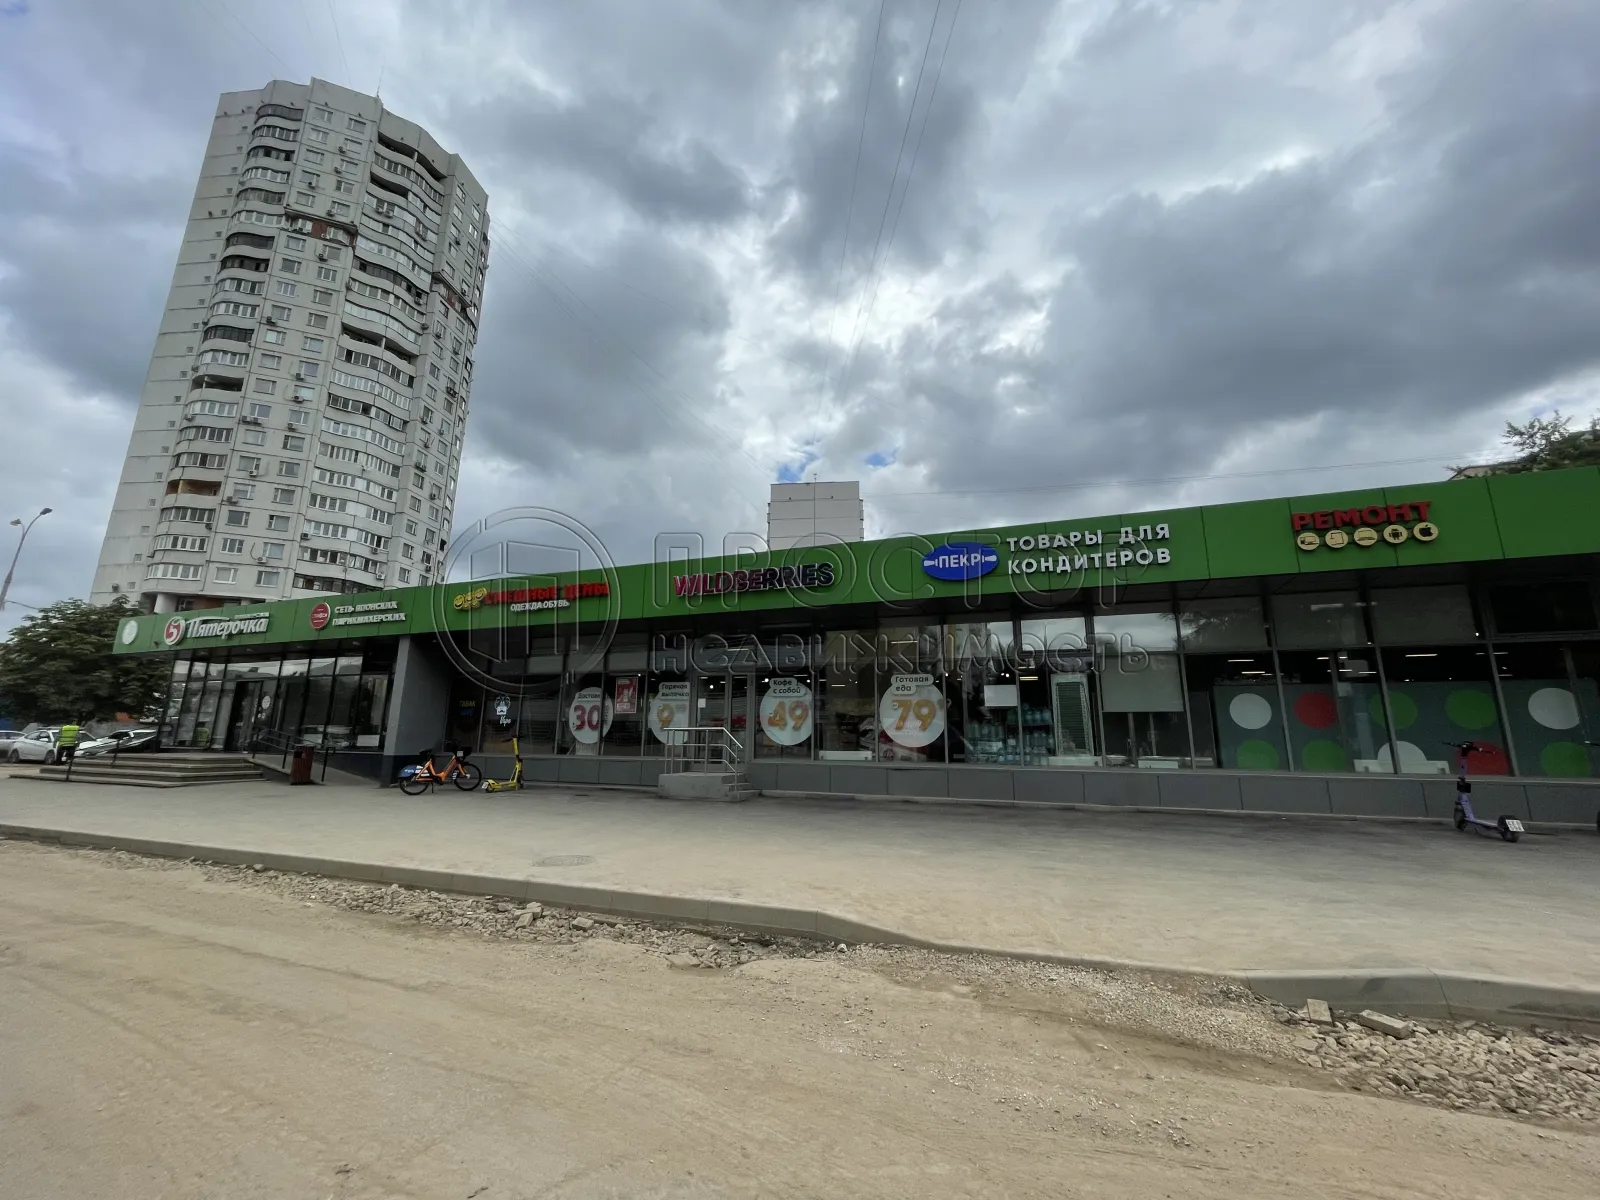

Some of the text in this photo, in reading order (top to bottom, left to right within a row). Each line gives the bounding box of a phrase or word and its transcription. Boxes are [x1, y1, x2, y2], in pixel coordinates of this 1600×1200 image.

[1292, 501, 1431, 530] РЕМОНТ
[1007, 523, 1171, 552] ТОВАРЫ ДЛЯ
[938, 553, 982, 569] ПЕКР
[1008, 548, 1172, 575] КОНДИТЕРОВ
[673, 561, 836, 597] WILDBERRIES
[334, 605, 355, 614] СЕТЬ
[510, 600, 569, 612] ОДЕЖДА ОБУВЬ
[186, 616, 270, 639] Пятерочка
[773, 679, 793, 687] Кофе
[778, 686, 801, 695] собой
[895, 675, 930, 684] Готовая
[895, 684, 912, 693] еда
[573, 704, 600, 730] 30
[768, 700, 810, 730] 49
[892, 699, 937, 731] 79
